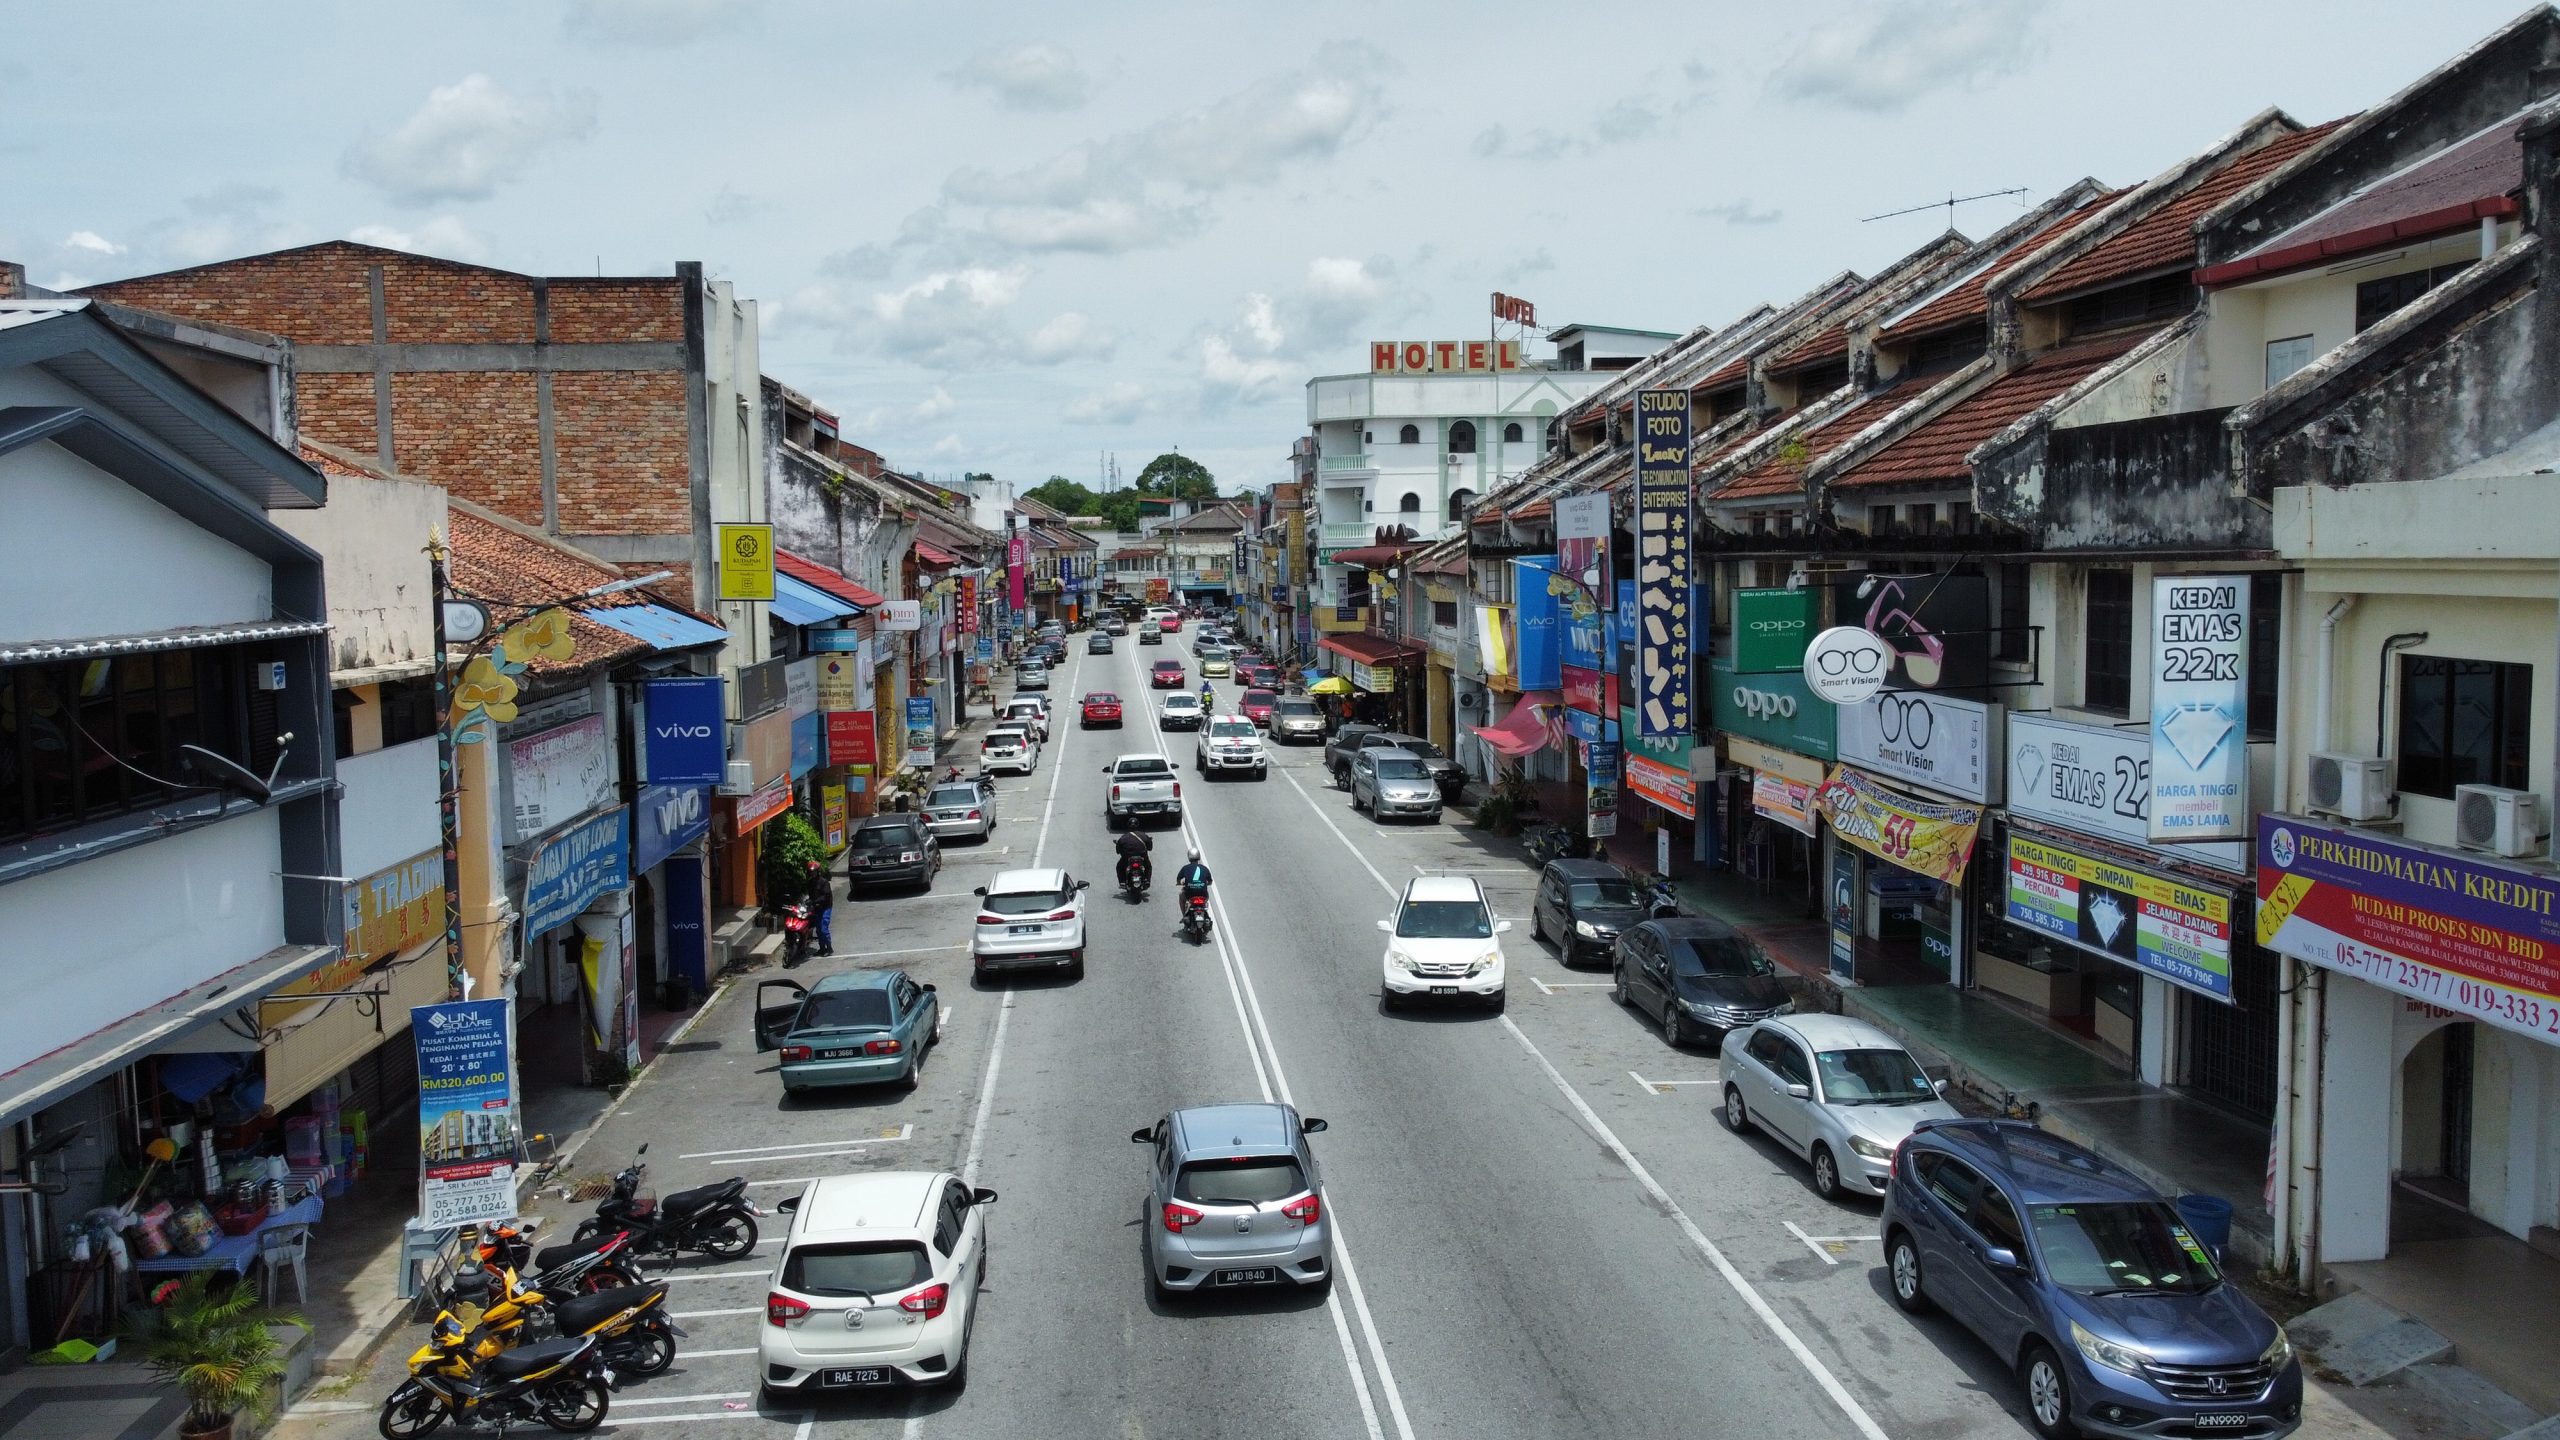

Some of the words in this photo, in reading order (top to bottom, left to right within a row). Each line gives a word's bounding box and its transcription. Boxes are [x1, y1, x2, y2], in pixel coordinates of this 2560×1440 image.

[1495, 292, 1536, 328] HOTEL
[1376, 344, 1515, 370] HOTEL
[1641, 392, 1687, 412] STUDIO
[1647, 416, 1682, 436] FOTO
[1641, 442, 1686, 463] Lucky
[1642, 491, 1687, 508] ENTERPRISE
[2170, 586, 2236, 610] KEDAI
[1524, 615, 1555, 625] vivo
[1750, 620, 1806, 631] oppo
[2163, 613, 2241, 643] EMAS
[2163, 647, 2239, 682] 22K
[1820, 677, 1849, 688] Smart
[1851, 675, 1880, 686] Vision
[1733, 686, 1797, 720] oppo
[656, 723, 711, 738] vivo
[1878, 743, 1903, 763] Smart
[1905, 751, 1934, 773] Vision
[2051, 742, 2080, 763] KEDAI
[2050, 763, 2106, 810] EMAS
[2156, 784, 2196, 798] HARGA
[2200, 784, 2238, 797] TINGGI
[657, 787, 699, 836] vivo
[2175, 800, 2218, 812] membeli
[2162, 815, 2194, 828] EMAS
[2197, 814, 2231, 827] LAMA
[1881, 813, 1917, 860] 50
[2014, 842, 2044, 863] HARGA
[2046, 853, 2077, 873] TINGGI
[2095, 866, 2134, 890] SIMPAN
[2174, 889, 2206, 912] EMAS
[2051, 874, 2065, 886] 835
[2299, 834, 2457, 893] PERKHIDMATAN
[2463, 872, 2555, 915] KREDIT
[344, 885, 362, 933] E
[371, 849, 445, 918] TRADIN
[2024, 880, 2060, 899] PERCUMA
[2028, 895, 2057, 913] MENILAI
[672, 921, 699, 929] vivo
[2050, 918, 2064, 930] 375
[2145, 903, 2183, 924] SELAMAT
[2184, 913, 2218, 935] DATANG
[2351, 893, 2404, 922] MUDAH
[2408, 909, 2468, 940] PROSES
[2470, 926, 2503, 949] SDN
[2508, 936, 2544, 961] BHD
[1925, 936, 1951, 957] opp
[2161, 939, 2202, 963] WELCOME
[2453, 942, 2482, 958] PERMIT
[2372, 931, 2395, 944] JALAN
[2395, 937, 2431, 956] KANGSAR
[2431, 947, 2457, 964] KUALA
[2499, 968, 2520, 982] 33000
[2150, 953, 2165, 968] TEL:
[2166, 960, 2192, 978] 05-776
[2193, 968, 2213, 986] 7906
[2336, 942, 2392, 979] 05-777
[2398, 961, 2442, 995] 2377
[2460, 980, 2540, 1027] 019-333
[2547, 1008, 2560, 1034] 2
[442, 1019, 492, 1031] SQUARE
[448, 1011, 477, 1023] UNI
[421, 1043, 470, 1053] PENGINAPAN
[472, 1040, 503, 1049] PELAJAR
[448, 1033, 492, 1043] KOMERSIAL
[429, 1055, 453, 1063] KEDAI
[422, 1072, 505, 1090] RM320,600.00
[461, 1180, 490, 1188] KANCIL
[432, 1205, 477, 1218] 012-588
[481, 1200, 507, 1212] 0242
[435, 1196, 473, 1209] 05-777
[478, 1192, 502, 1203] 7571
[1227, 1272, 1244, 1281] AMD
[1245, 1270, 1266, 1280] 1840
[835, 1371, 853, 1382] RAE
[856, 1370, 879, 1381] 7275
